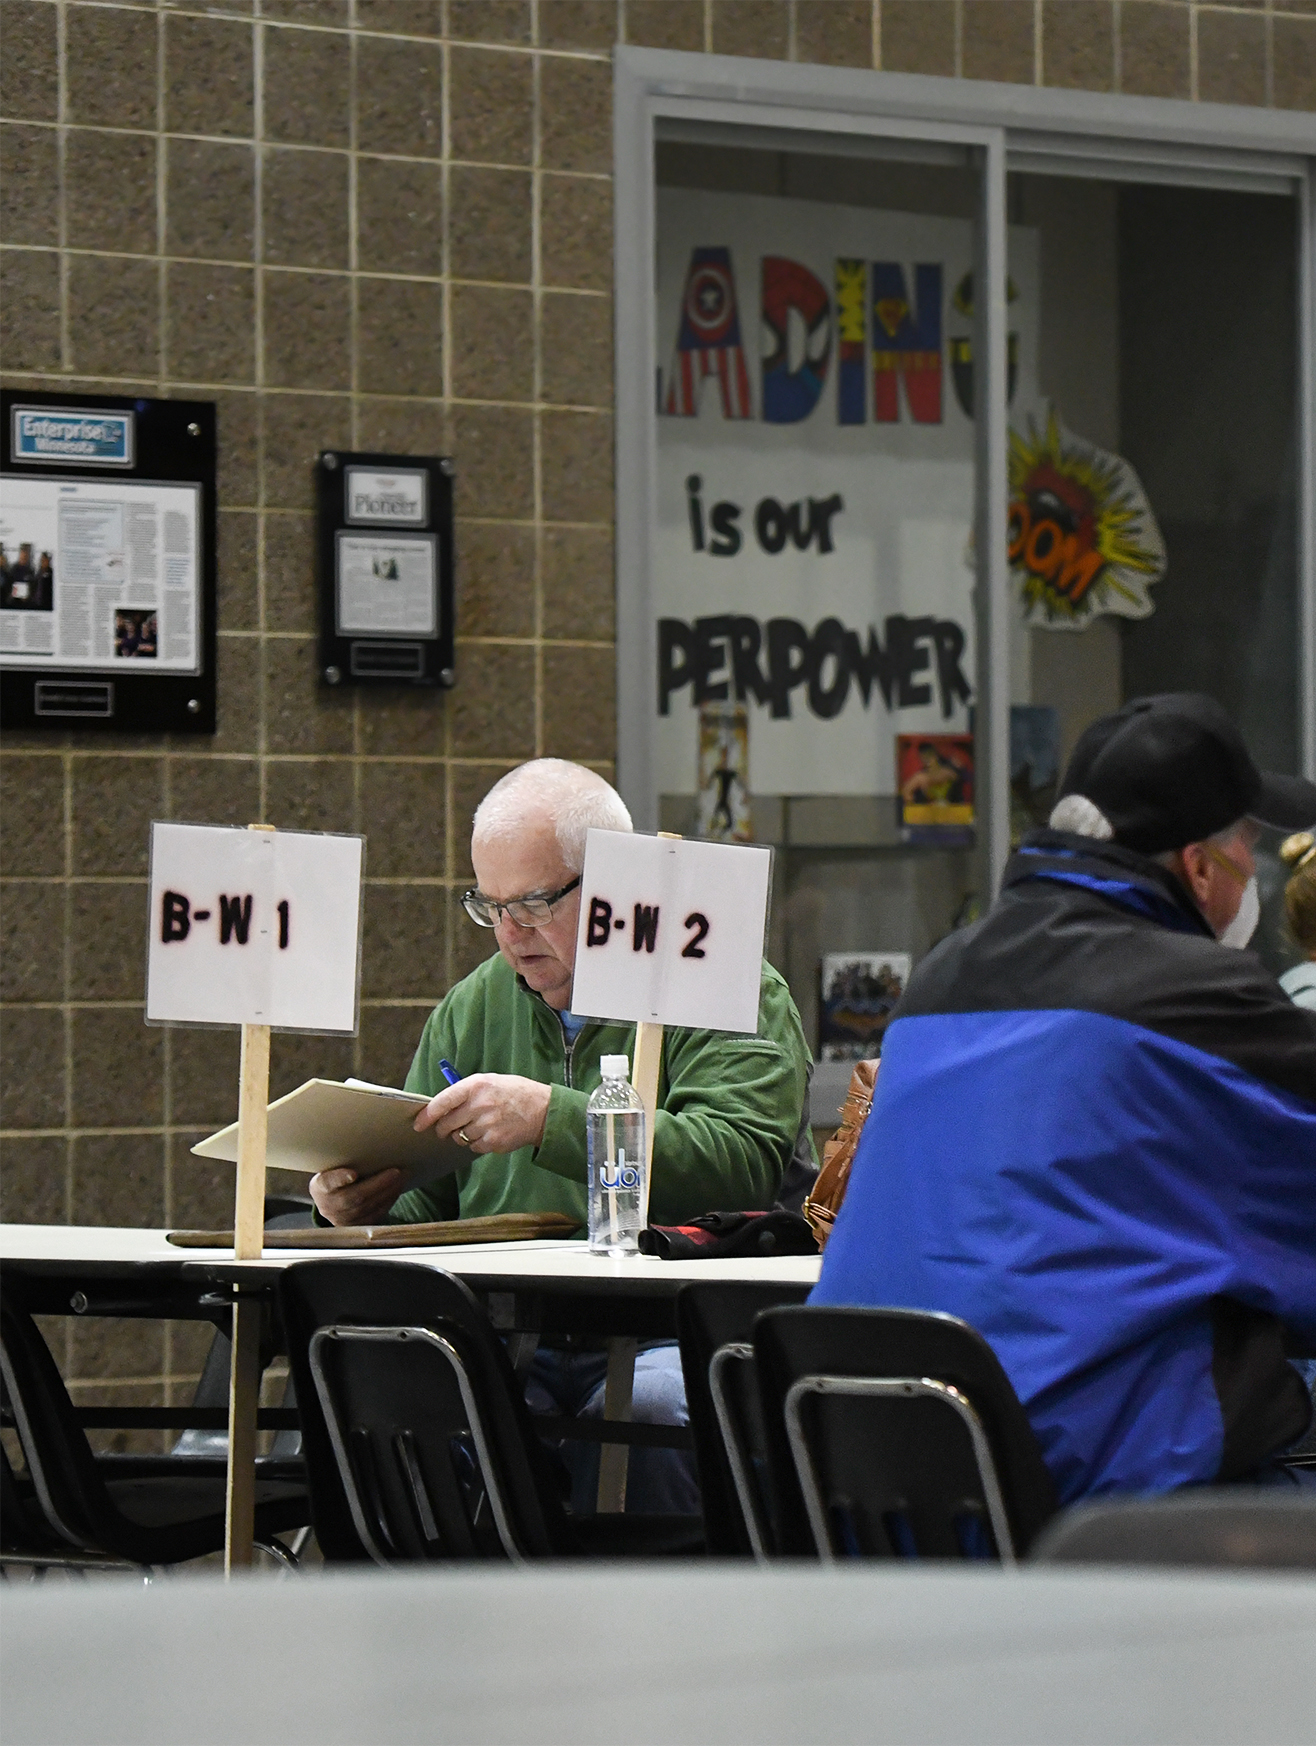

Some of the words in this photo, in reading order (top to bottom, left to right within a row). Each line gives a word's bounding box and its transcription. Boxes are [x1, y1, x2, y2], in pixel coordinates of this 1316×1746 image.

[655, 246, 1016, 426] ADIN
[23, 416, 106, 441] Enterprise
[35, 437, 96, 454] Minnesota
[354, 493, 419, 515] Pioneer
[686, 473, 742, 557] is
[755, 493, 844, 555] our
[656, 612, 973, 720] PERPOWER
[161, 889, 253, 945] B-W
[277, 899, 290, 950] 1
[587, 896, 660, 954] B-W
[681, 911, 710, 959] 2
[599, 1147, 641, 1189] üb
